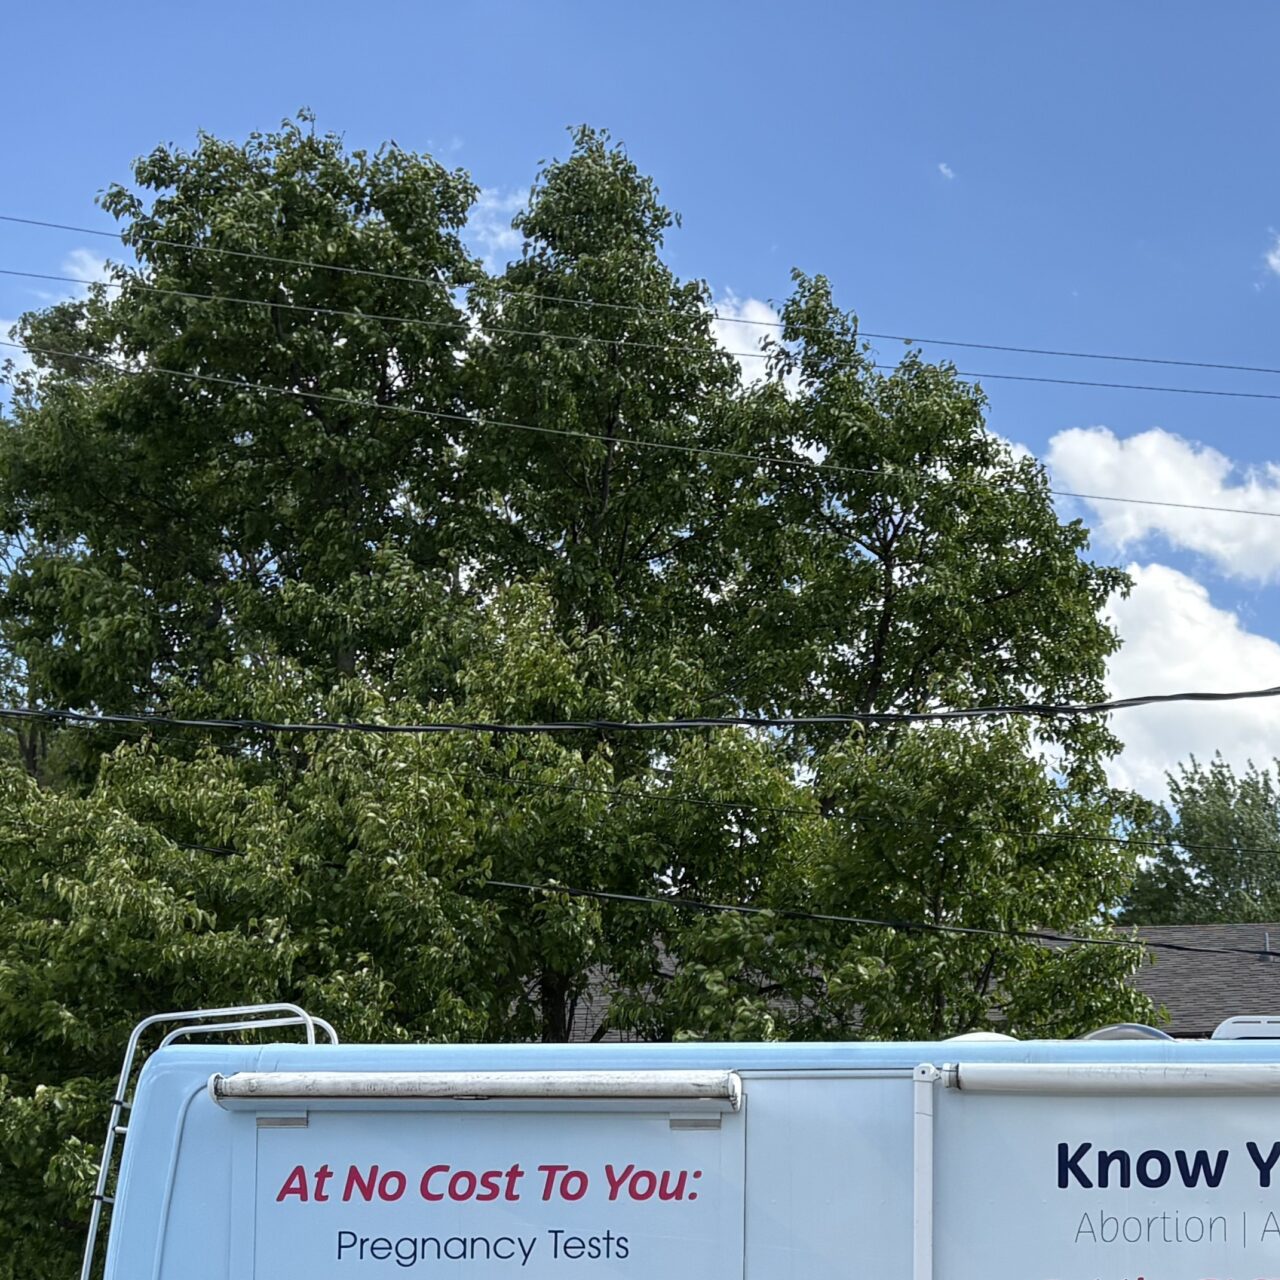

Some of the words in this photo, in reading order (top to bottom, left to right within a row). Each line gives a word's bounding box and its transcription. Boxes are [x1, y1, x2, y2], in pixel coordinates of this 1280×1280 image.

[275, 1165, 333, 1202] At
[342, 1164, 407, 1202] No
[419, 1164, 525, 1202] Cost
[537, 1164, 589, 1202] To
[604, 1164, 703, 1201] You:
[1057, 1142, 1230, 1189] Know
[1074, 1209, 1228, 1243] Abortion
[337, 1230, 537, 1268] Pregnancy
[547, 1229, 630, 1261] Tests
